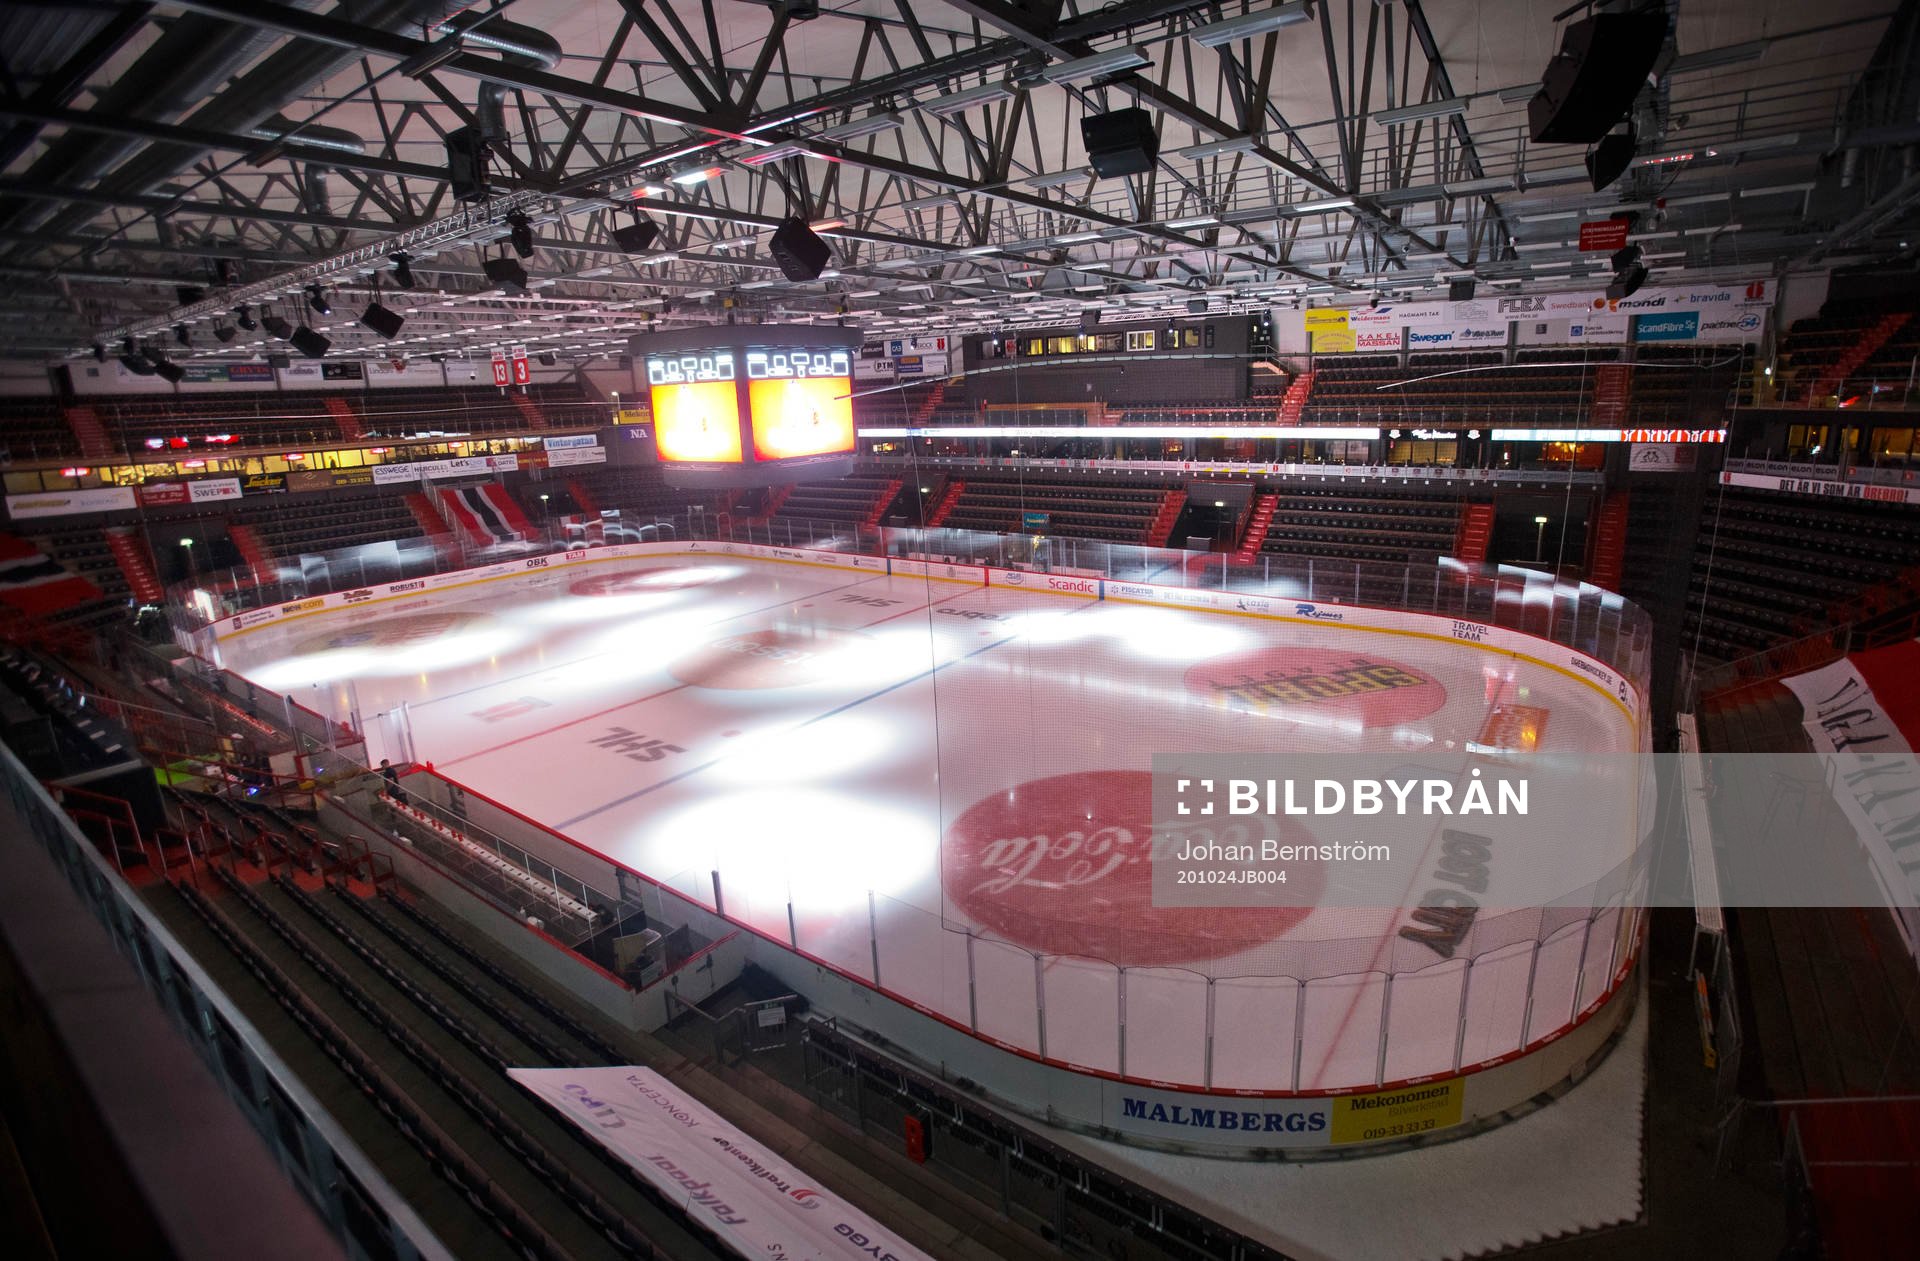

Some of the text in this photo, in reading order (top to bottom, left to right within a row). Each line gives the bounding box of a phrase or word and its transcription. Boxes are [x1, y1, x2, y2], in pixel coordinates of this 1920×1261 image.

[1497, 296, 1547, 314] FLEX
[1618, 297, 1666, 309] mondi
[1690, 292, 1731, 303] bravida
[1410, 332, 1453, 344] Swegon
[495, 364, 506, 382] 13
[518, 361, 526, 380] 3
[630, 429, 648, 439] NA
[1768, 463, 1788, 472] elon
[1791, 465, 1812, 473] elon
[1815, 466, 1837, 475] elon
[194, 487, 238, 498] SWEPX
[1779, 479, 1794, 490] DET
[1812, 481, 1821, 493] VI
[1823, 483, 1845, 496] SOM
[526, 556, 549, 568] OBK
[1048, 577, 1095, 594] Scandic
[1452, 620, 1489, 635] TRAVEL
[1452, 629, 1481, 642] TEAM
[587, 726, 690, 763] SHL
[1351, 1086, 1449, 1112] Mekonomen
[1122, 1098, 1327, 1132] MALMBERGS
[1388, 1099, 1449, 1116] Bilverkstad
[712, 1136, 791, 1194] Trafikcenter
